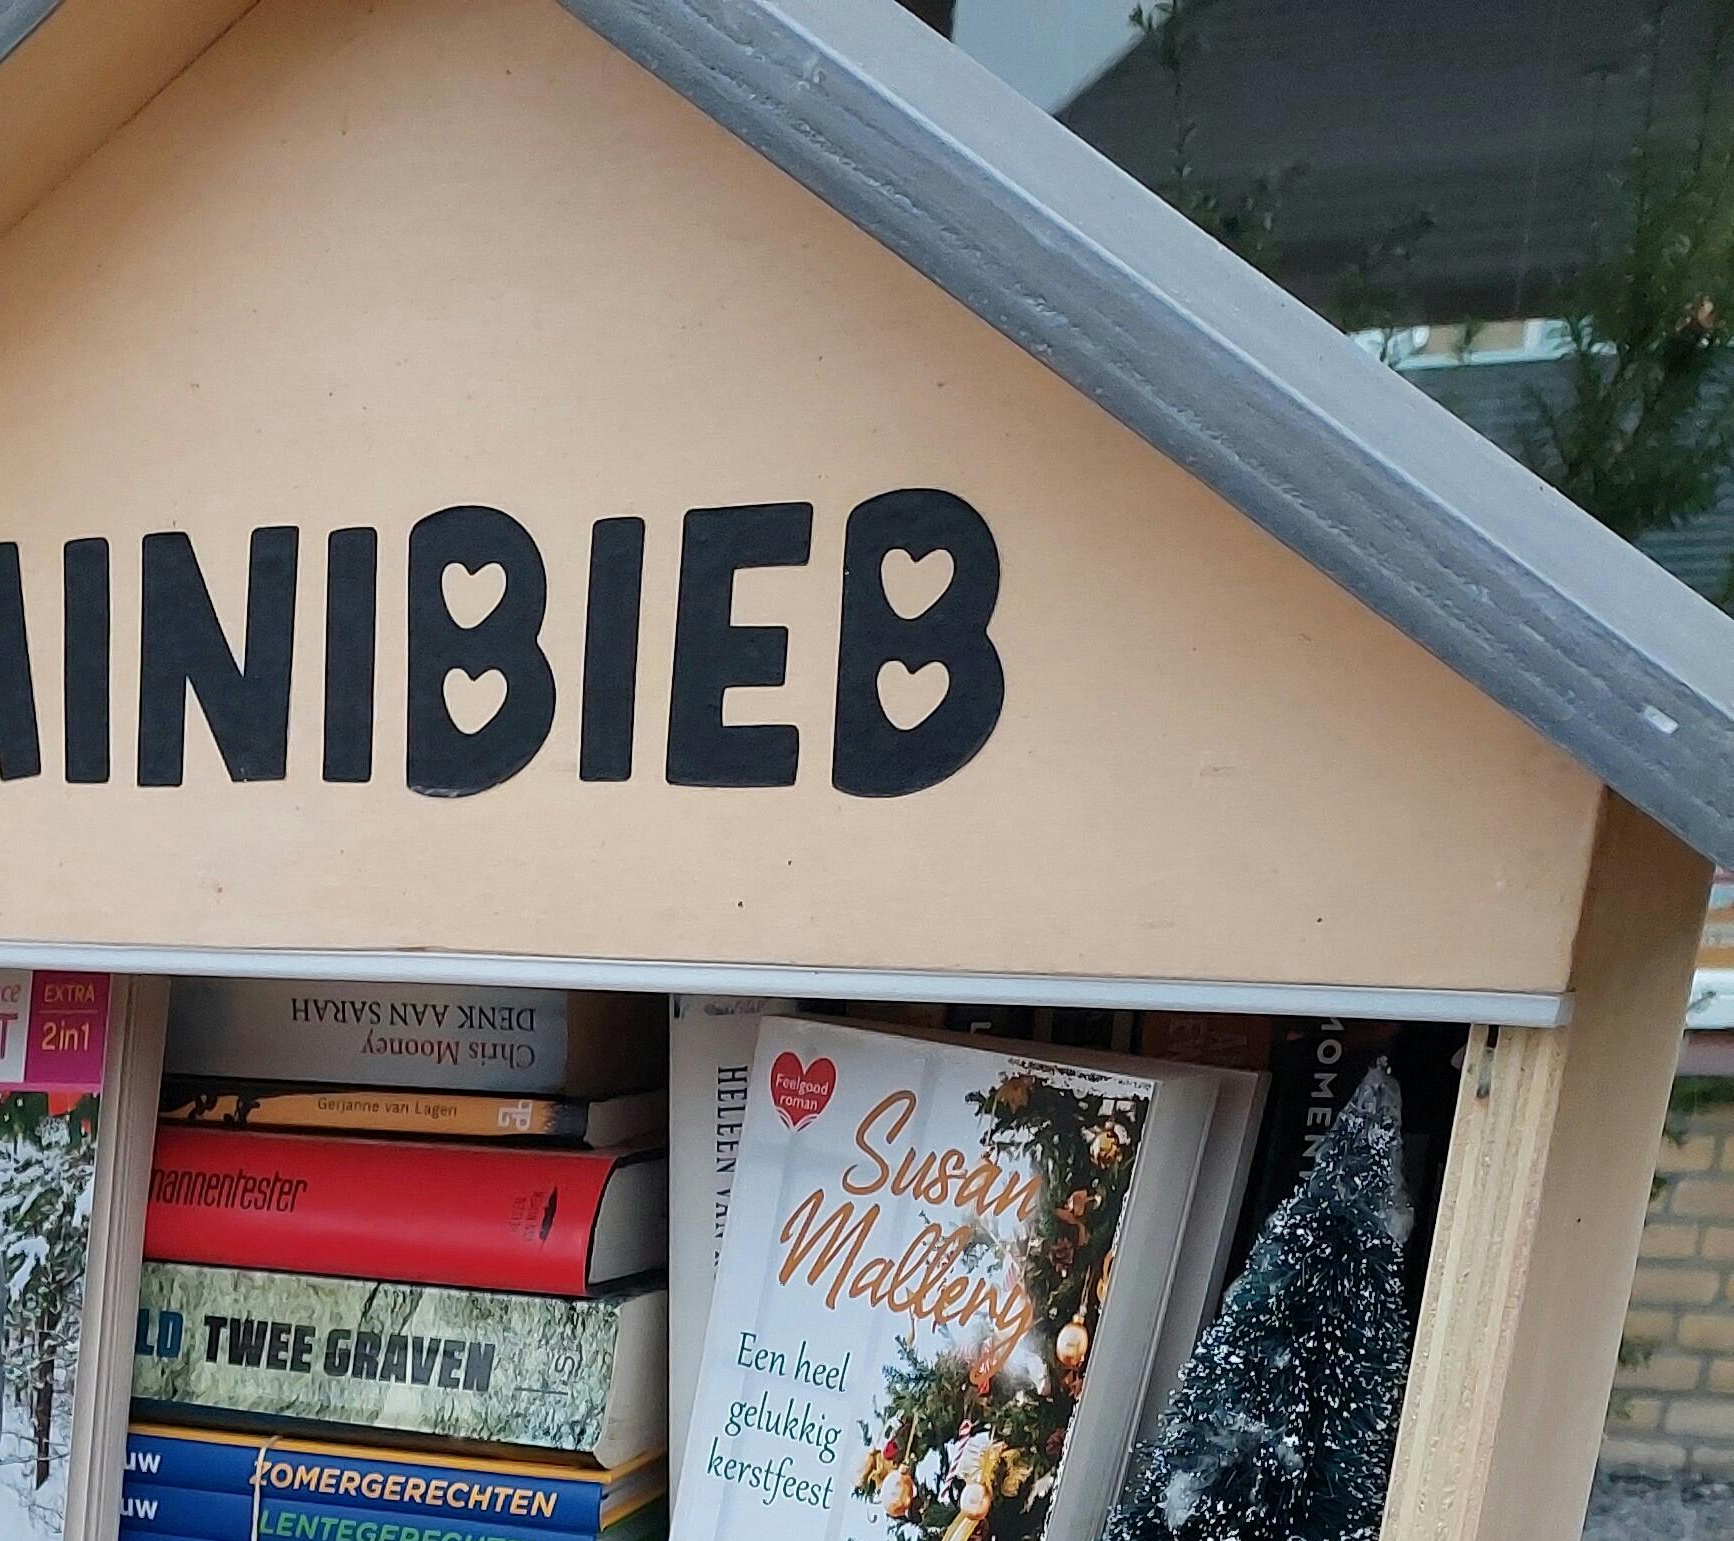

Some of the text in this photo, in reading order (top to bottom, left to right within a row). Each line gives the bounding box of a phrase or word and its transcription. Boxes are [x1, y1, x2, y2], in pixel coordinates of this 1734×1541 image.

[44, 983, 95, 1003] EXTRA
[291, 998, 537, 1032] DENK AAN SARAH
[42, 1022, 90, 1051] 2in1
[362, 1028, 536, 1070] Chris Mooney
[317, 1096, 458, 1118] Gerjanne van Lagen
[775, 1073, 829, 1095] Feelgood
[780, 1094, 818, 1111] roman
[717, 1065, 748, 1173] HELEEN
[842, 1090, 1044, 1222] Susan
[779, 1188, 1034, 1386] Mallery
[204, 1315, 496, 1393] TWEE GRAVEN
[737, 1331, 850, 1392] Een heel
[724, 1391, 842, 1463] gelukkig
[249, 1459, 558, 1519] ZOMERGERECHTEN
[707, 1437, 834, 1509] kerstfeest
